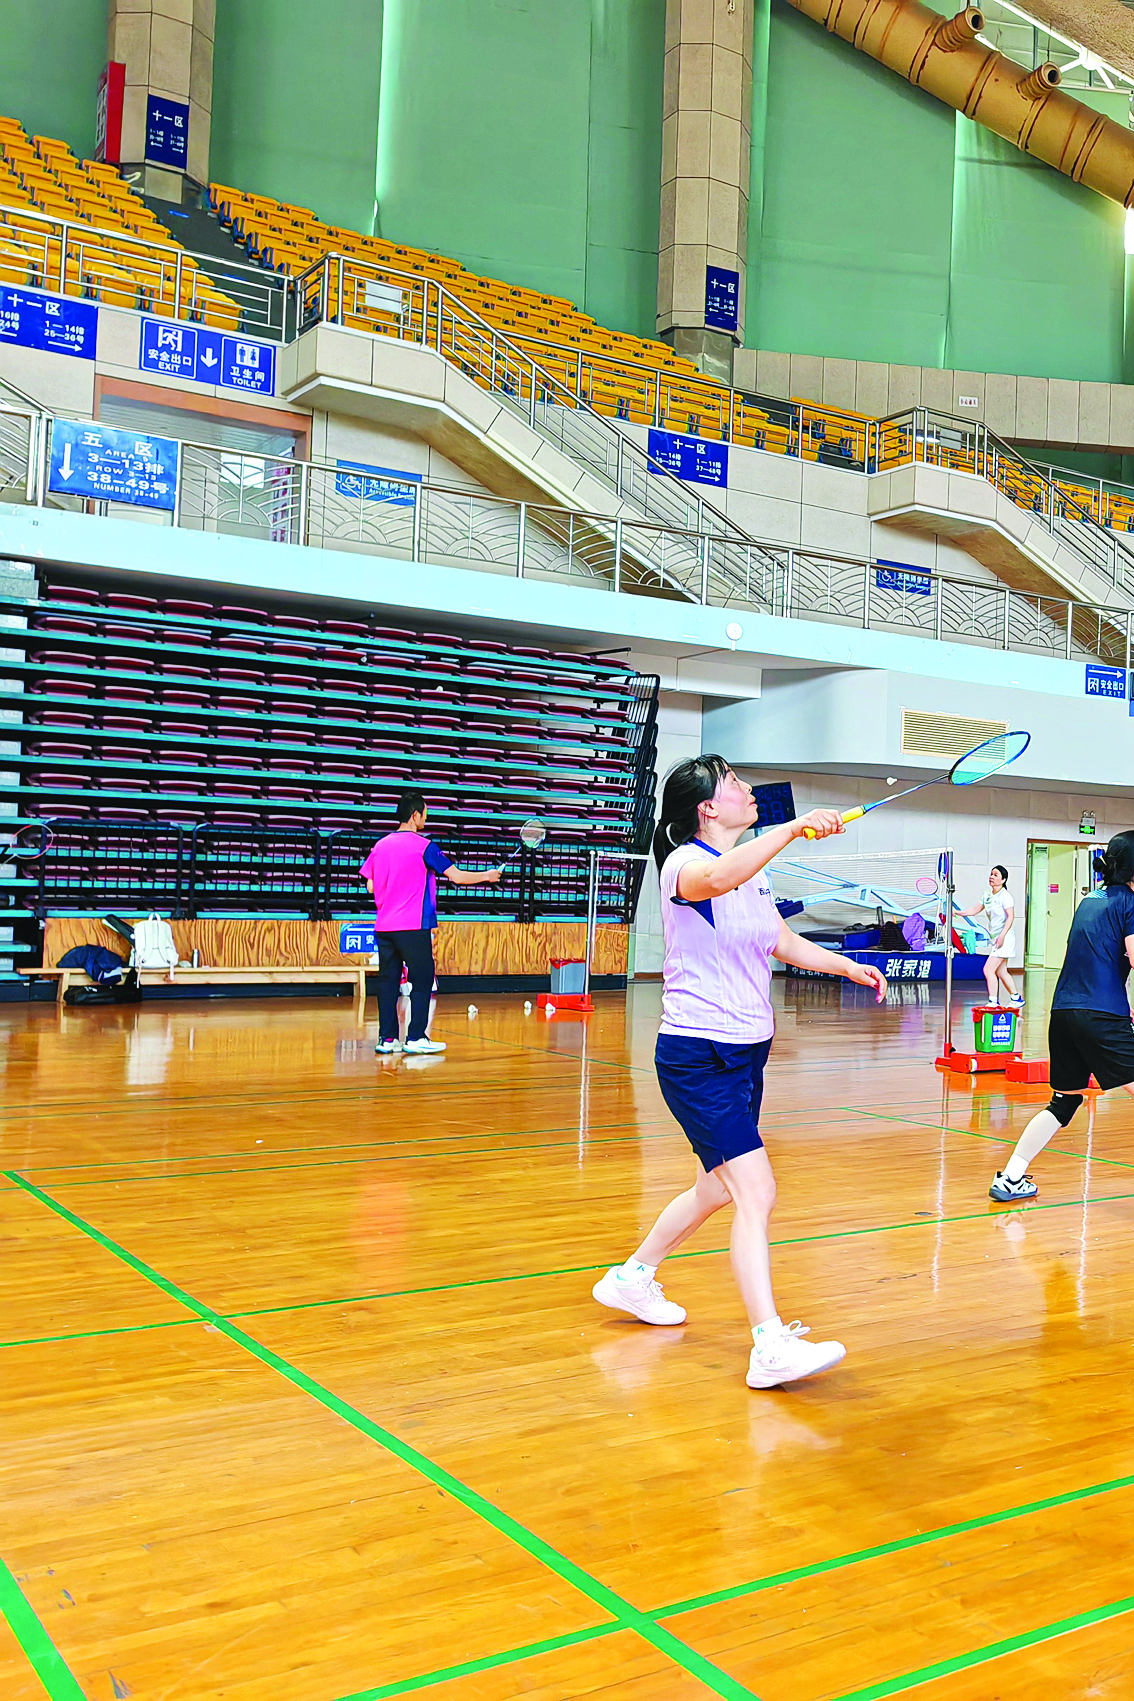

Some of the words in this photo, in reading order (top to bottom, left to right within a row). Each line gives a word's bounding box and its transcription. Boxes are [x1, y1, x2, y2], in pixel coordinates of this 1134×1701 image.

[152, 110, 183, 127] 十一区
[711, 278, 735, 293] 十一区
[7, 293, 60, 316] 十一区
[148, 348, 192, 366] 安全出口
[158, 361, 180, 372] EXIT
[230, 366, 265, 382] 卫生间
[232, 377, 262, 389] TOILET
[672, 438, 706, 454] 十一区
[104, 449, 134, 460] AREA
[95, 465, 124, 474] ROW
[93, 482, 131, 495] NUMBER
[1101, 680, 1123, 690] 安全出口
[885, 958, 931, 978] 张家港
